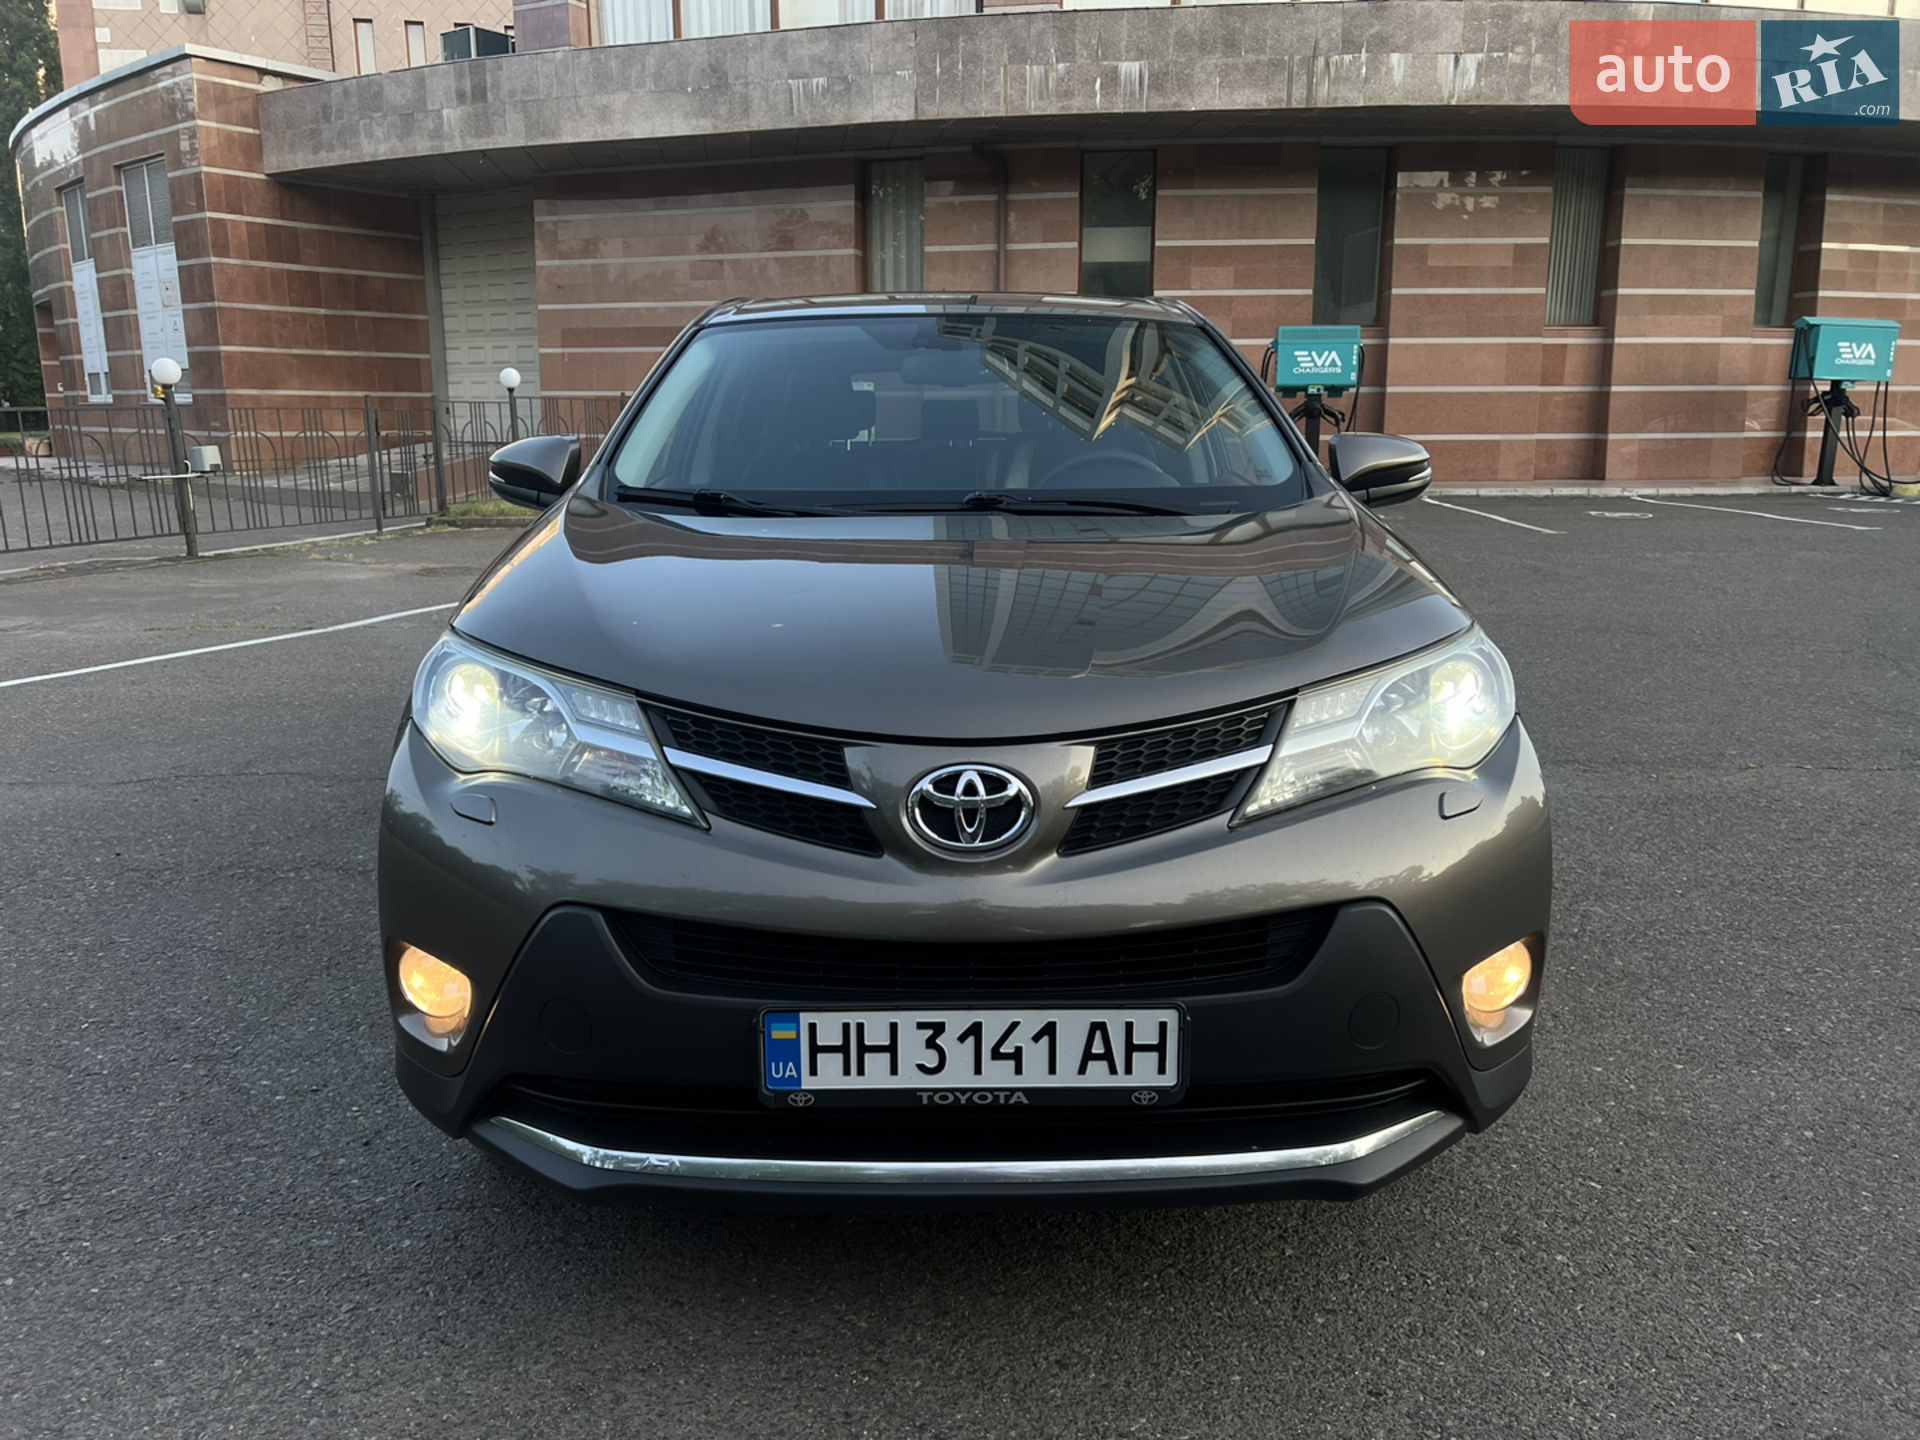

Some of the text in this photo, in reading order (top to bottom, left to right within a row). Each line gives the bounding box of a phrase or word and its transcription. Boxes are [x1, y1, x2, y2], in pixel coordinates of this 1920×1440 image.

[1293, 350, 1342, 367] EVA
[1837, 342, 1876, 358] EVA
[808, 1020, 1168, 1076] HH 3141 AH
[772, 1062, 798, 1079] UA
[917, 1092, 1029, 1105] TOYOTA
